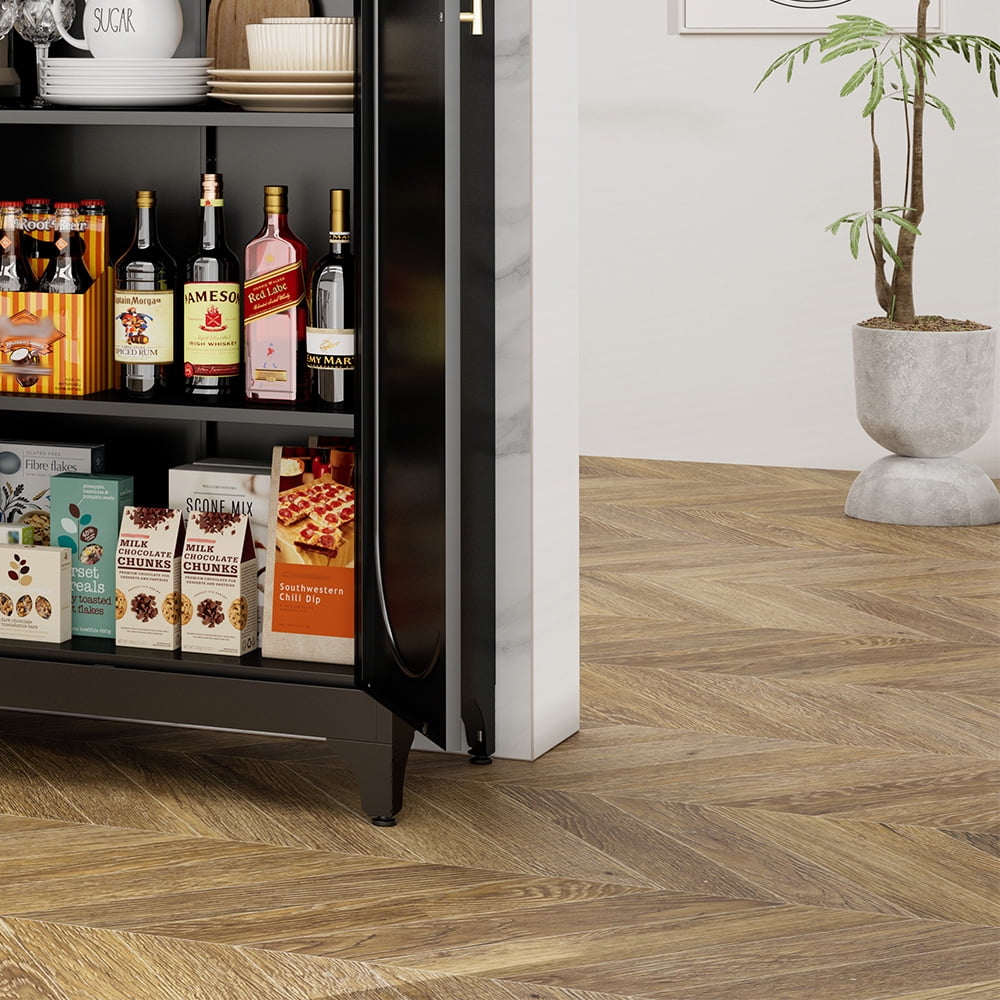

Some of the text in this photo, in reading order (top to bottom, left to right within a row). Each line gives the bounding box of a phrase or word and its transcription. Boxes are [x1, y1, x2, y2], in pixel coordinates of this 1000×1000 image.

[94, 8, 136, 32] SUGAR
[13, 217, 50, 232] Root
[248, 290, 266, 303] Red
[25, 459, 78, 472] Fibre flakes
[232, 500, 254, 516] MIX
[120, 539, 148, 548] MILK
[186, 544, 214, 553] MILK
[118, 548, 172, 558] CHOCOLATE
[184, 553, 239, 563] CHOCOLATE
[118, 556, 171, 569] CHUNKS
[183, 561, 238, 574] CHUNKS
[280, 582, 344, 595] Southwestern
[79, 595, 112, 605] toasted
[280, 593, 321, 605] Chili Dip
[78, 605, 104, 615] flakes
